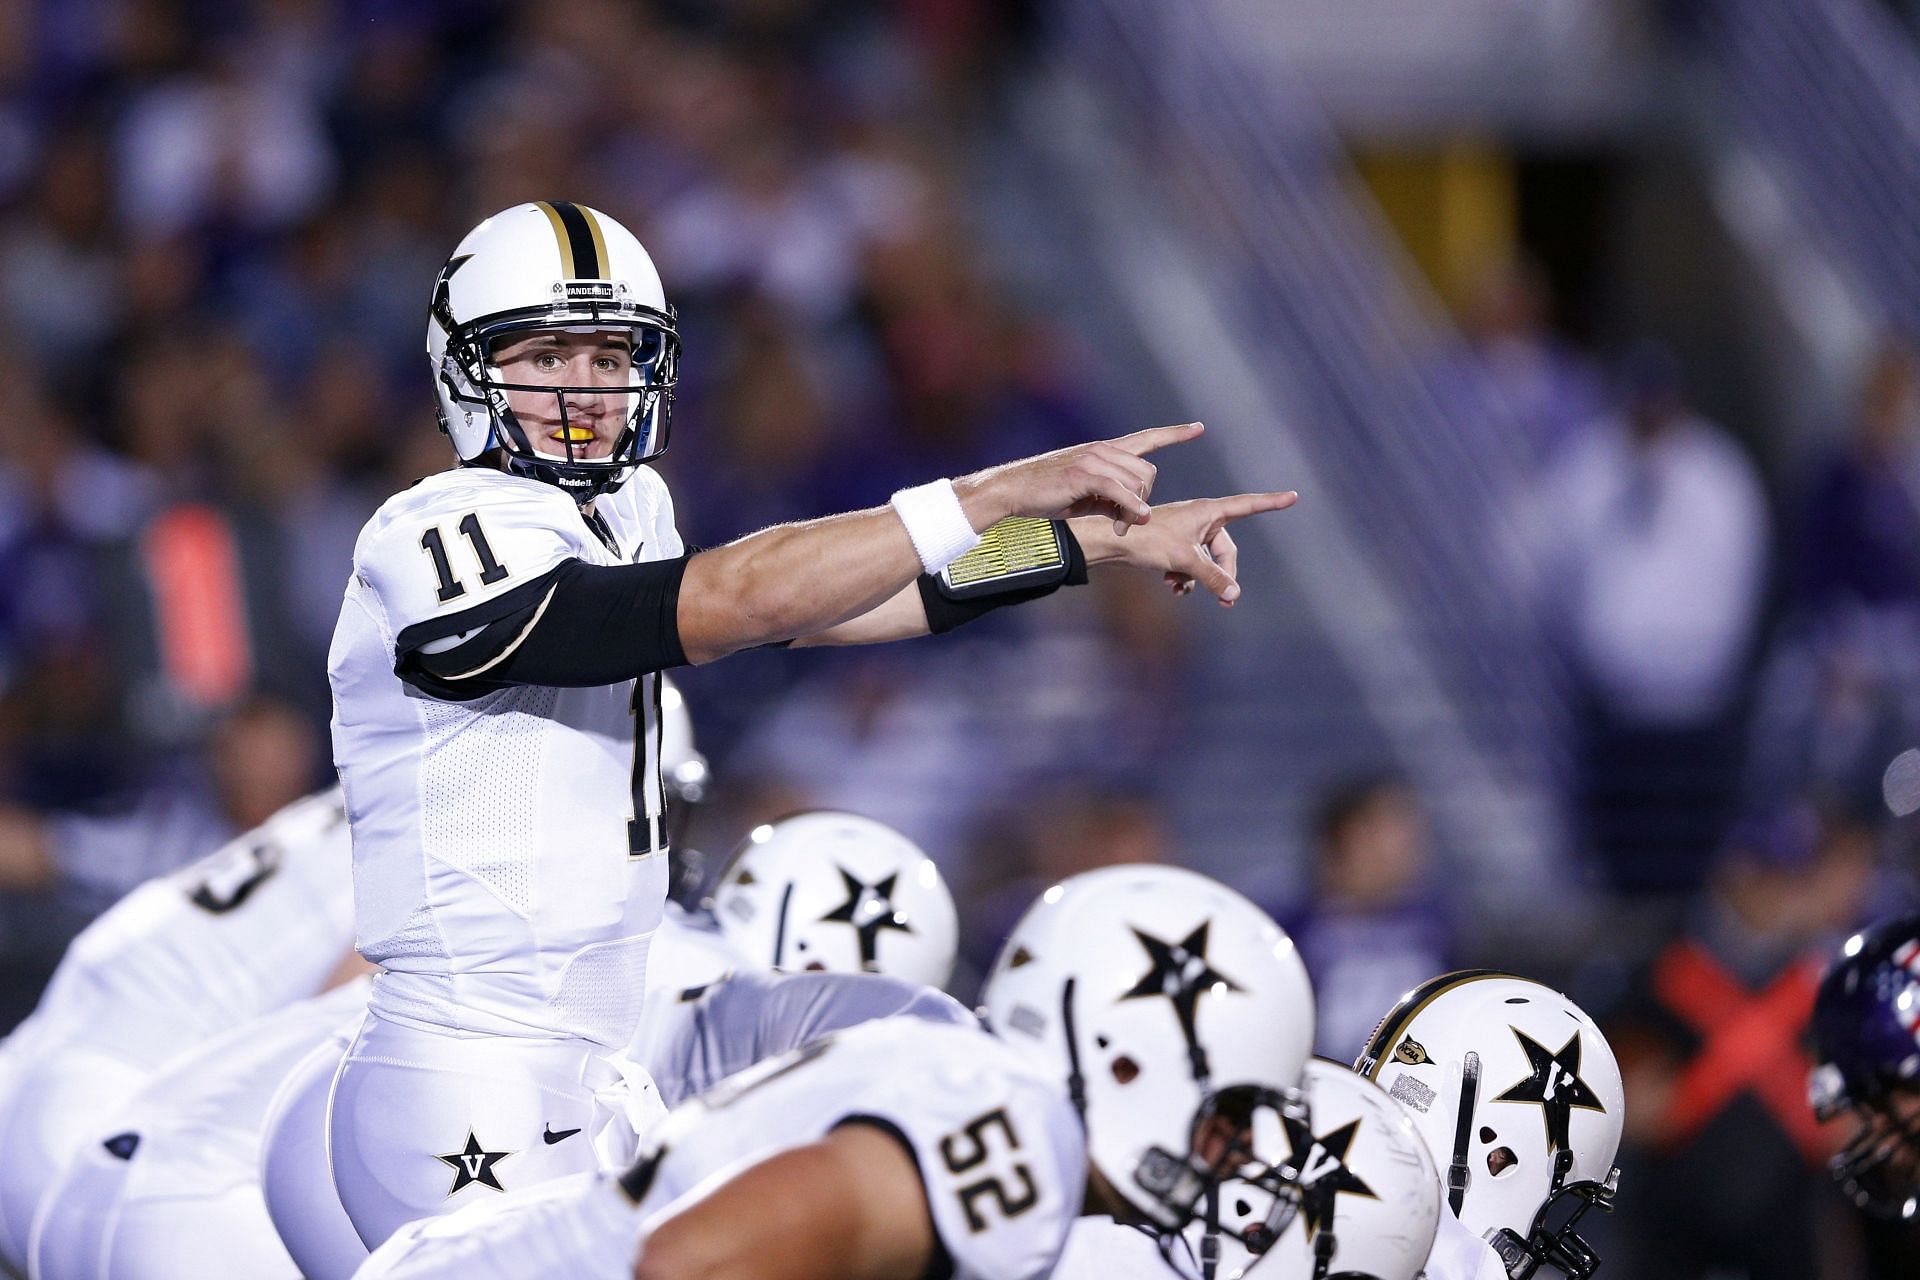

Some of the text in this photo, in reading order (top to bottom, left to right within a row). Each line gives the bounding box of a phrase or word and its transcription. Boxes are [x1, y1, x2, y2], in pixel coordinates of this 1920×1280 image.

[567, 287, 613, 296] VANDERBILT
[418, 509, 512, 607] 11
[461, 1154, 486, 1178] V
[938, 1105, 1040, 1236] 52
[1298, 1142, 1342, 1185] V
